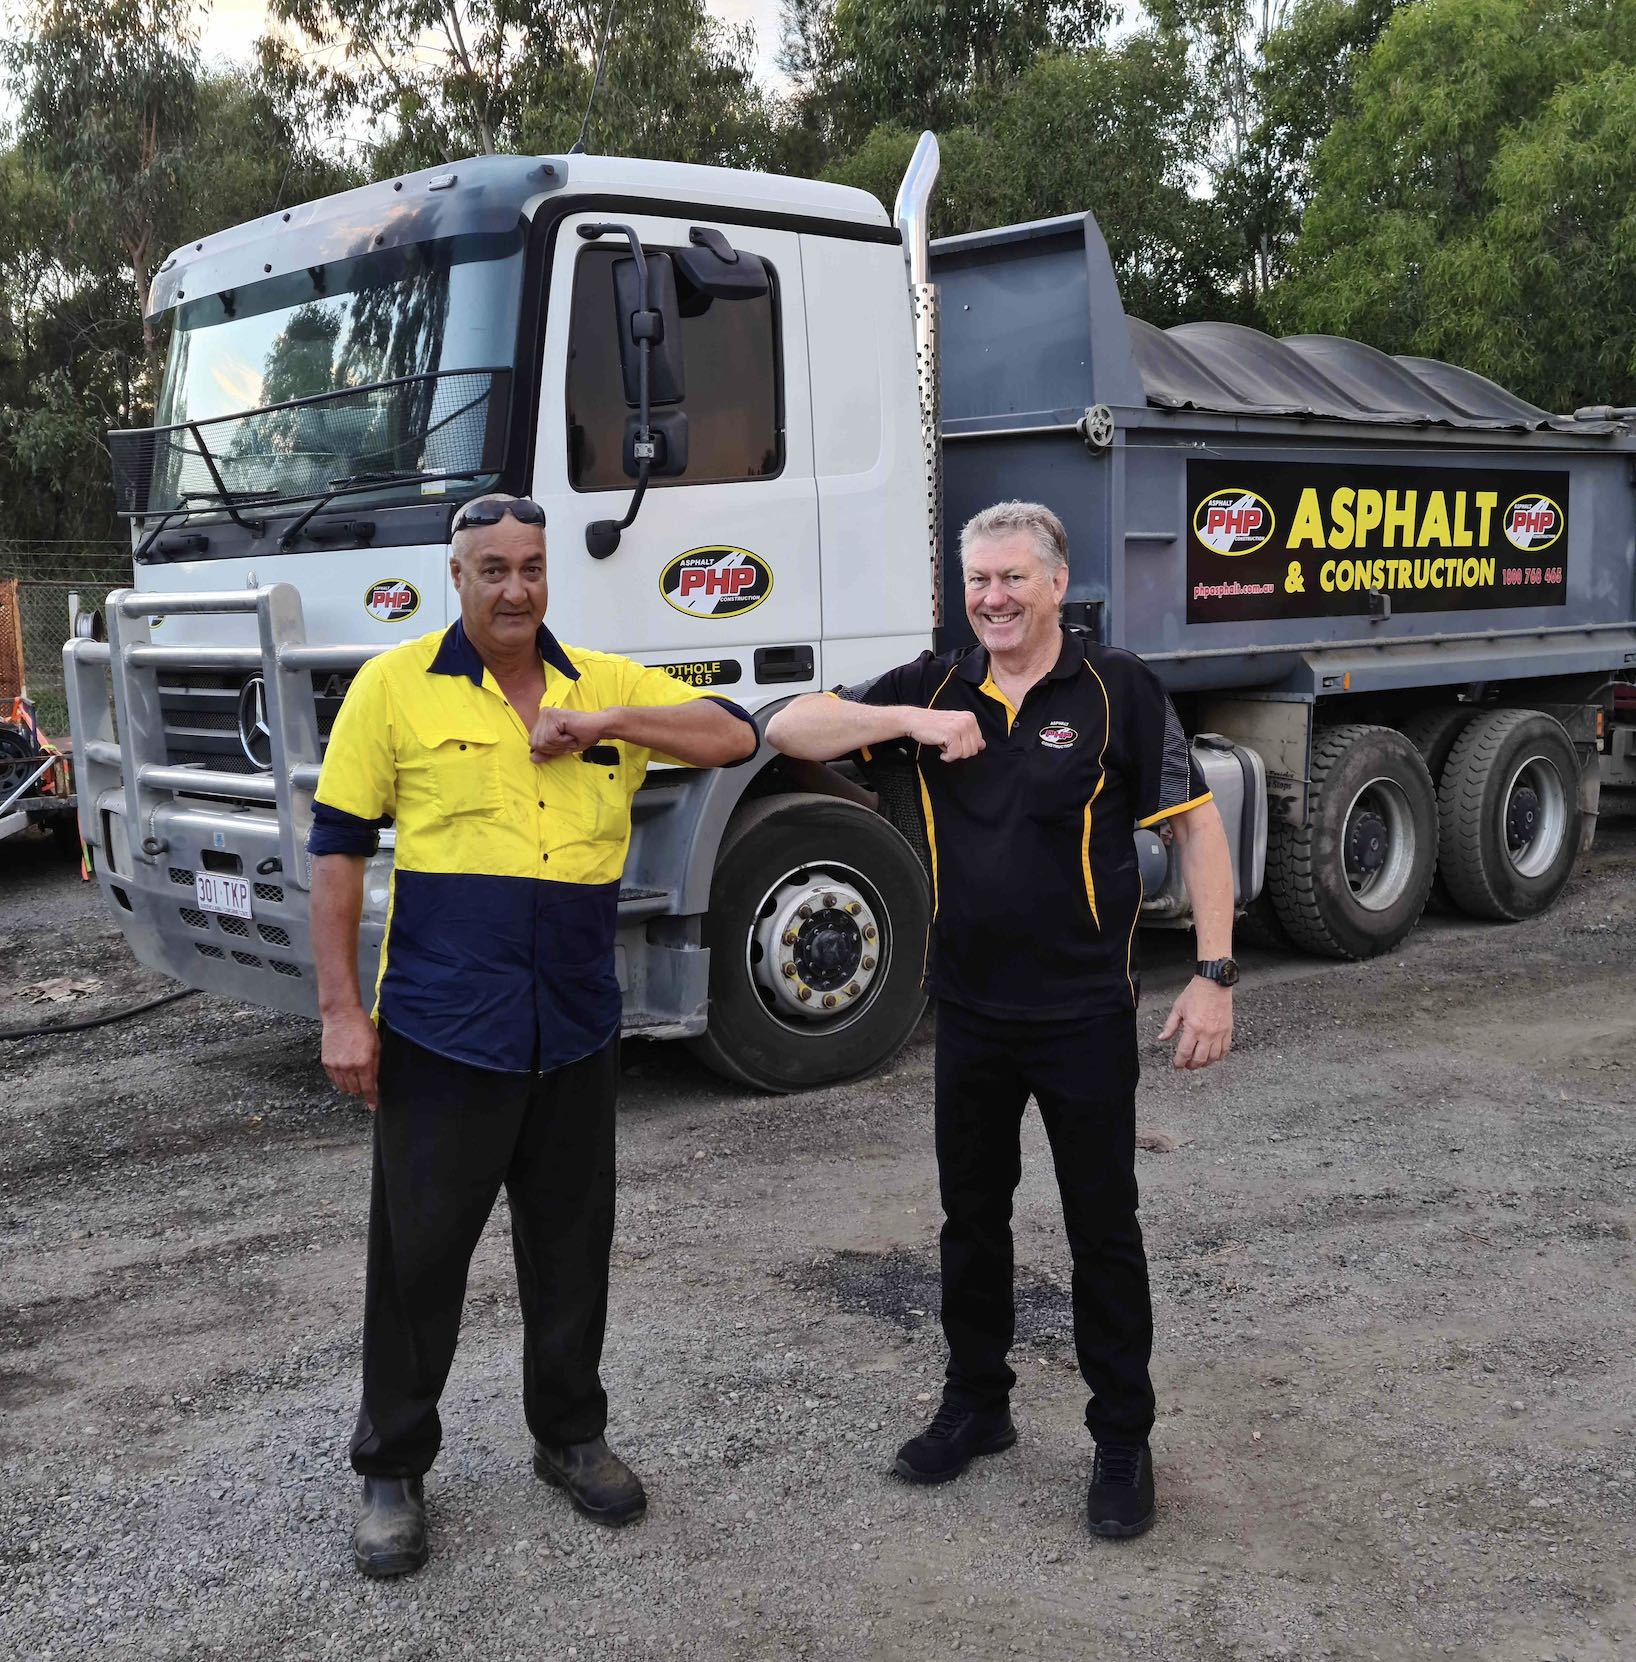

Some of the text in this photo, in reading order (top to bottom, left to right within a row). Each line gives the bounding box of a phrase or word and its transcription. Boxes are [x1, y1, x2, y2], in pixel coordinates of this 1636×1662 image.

[1207, 508, 1262, 535] PHP
[1286, 487, 1498, 550] ASPHALT
[1512, 510, 1555, 533] PHP
[680, 558, 714, 567] ASPHALT
[680, 567, 756, 597] PHP
[1284, 557, 1496, 593] & CONSTRUCTION
[372, 591, 411, 609] PHP
[720, 594, 761, 602] CONSTRUCTION
[1193, 581, 1275, 600] phpasphalt.com.au
[657, 662, 721, 677] OTHOLE
[198, 877, 218, 904] 301
[223, 881, 248, 909] TKP
